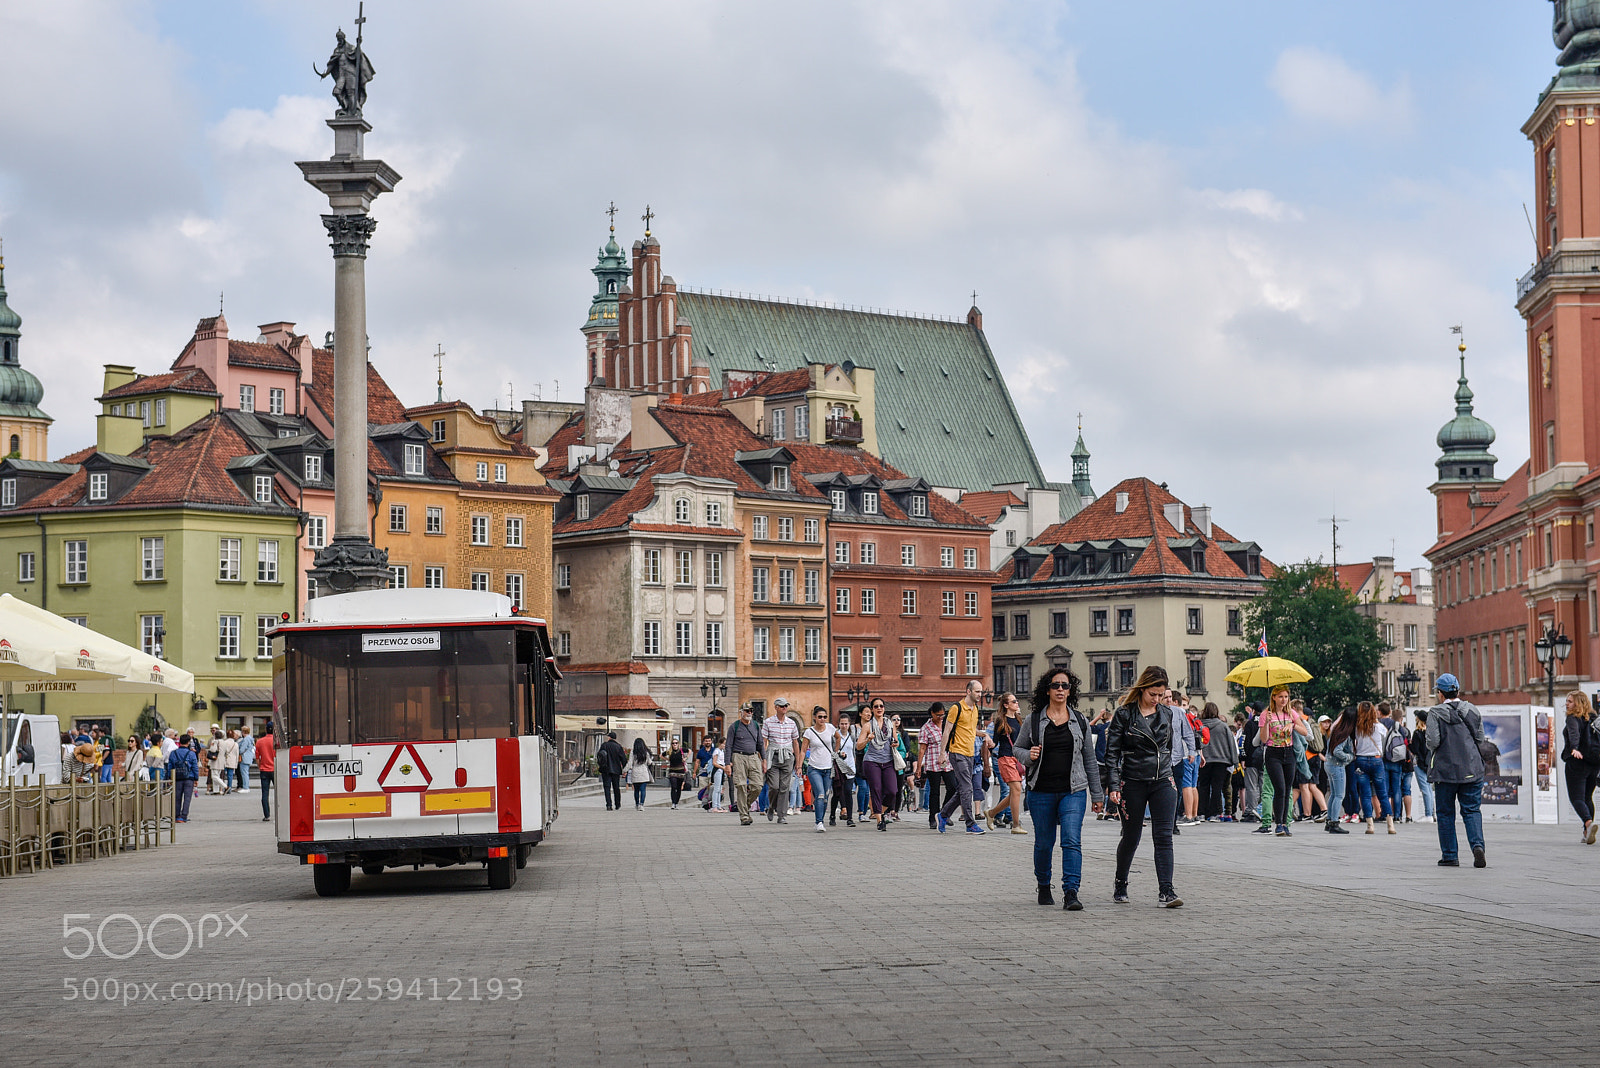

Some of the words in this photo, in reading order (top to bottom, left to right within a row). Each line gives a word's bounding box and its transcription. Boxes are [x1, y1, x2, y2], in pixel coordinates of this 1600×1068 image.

[368, 637, 409, 646] PRZEWÓZ
[410, 636, 434, 645] OSÓB
[322, 762, 360, 775] 104AC
